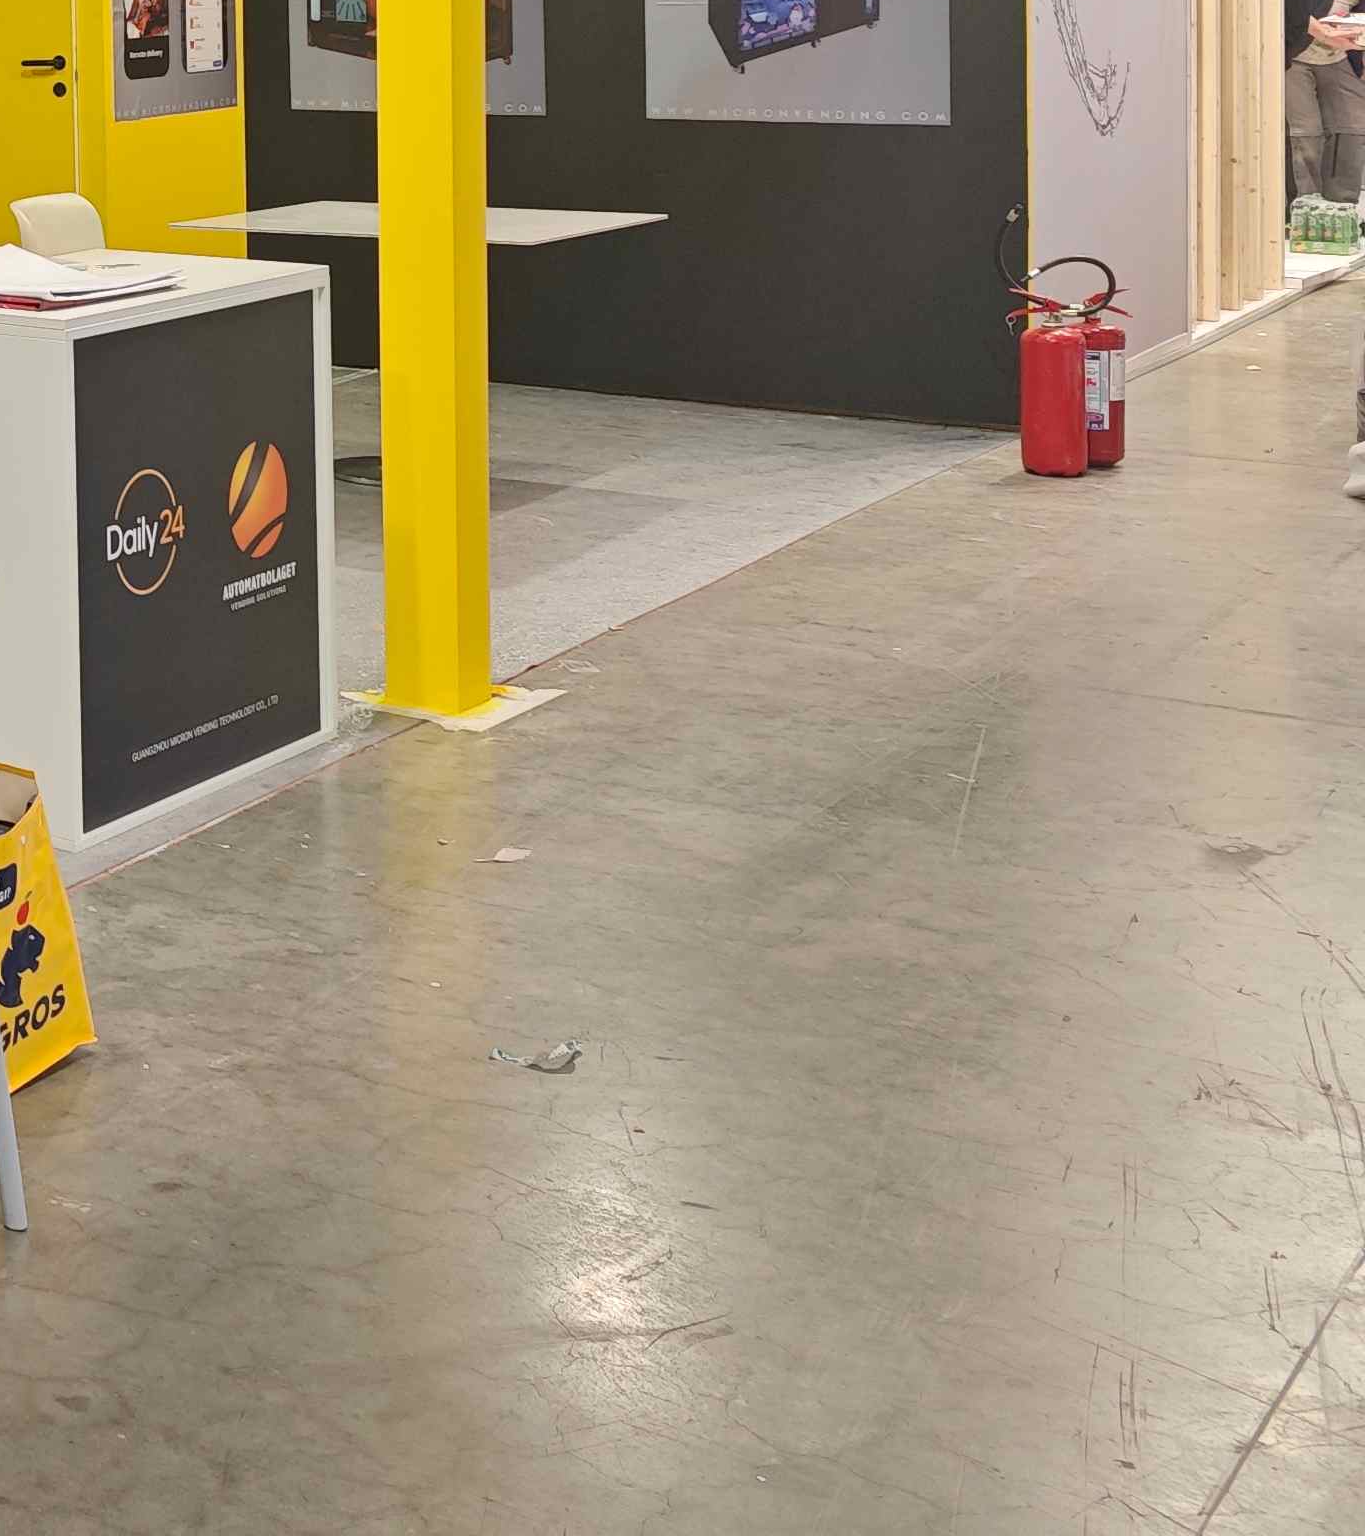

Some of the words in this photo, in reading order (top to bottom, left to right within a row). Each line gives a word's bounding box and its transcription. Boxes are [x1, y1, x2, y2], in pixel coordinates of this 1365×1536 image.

[222, 561, 297, 601] AUTOMATBOLAGET
[131, 739, 170, 762] GUANGZHOU
[169, 729, 193, 748] MICRON
[193, 718, 219, 737] VENDING
[218, 703, 256, 727] TECHNOLOGY
